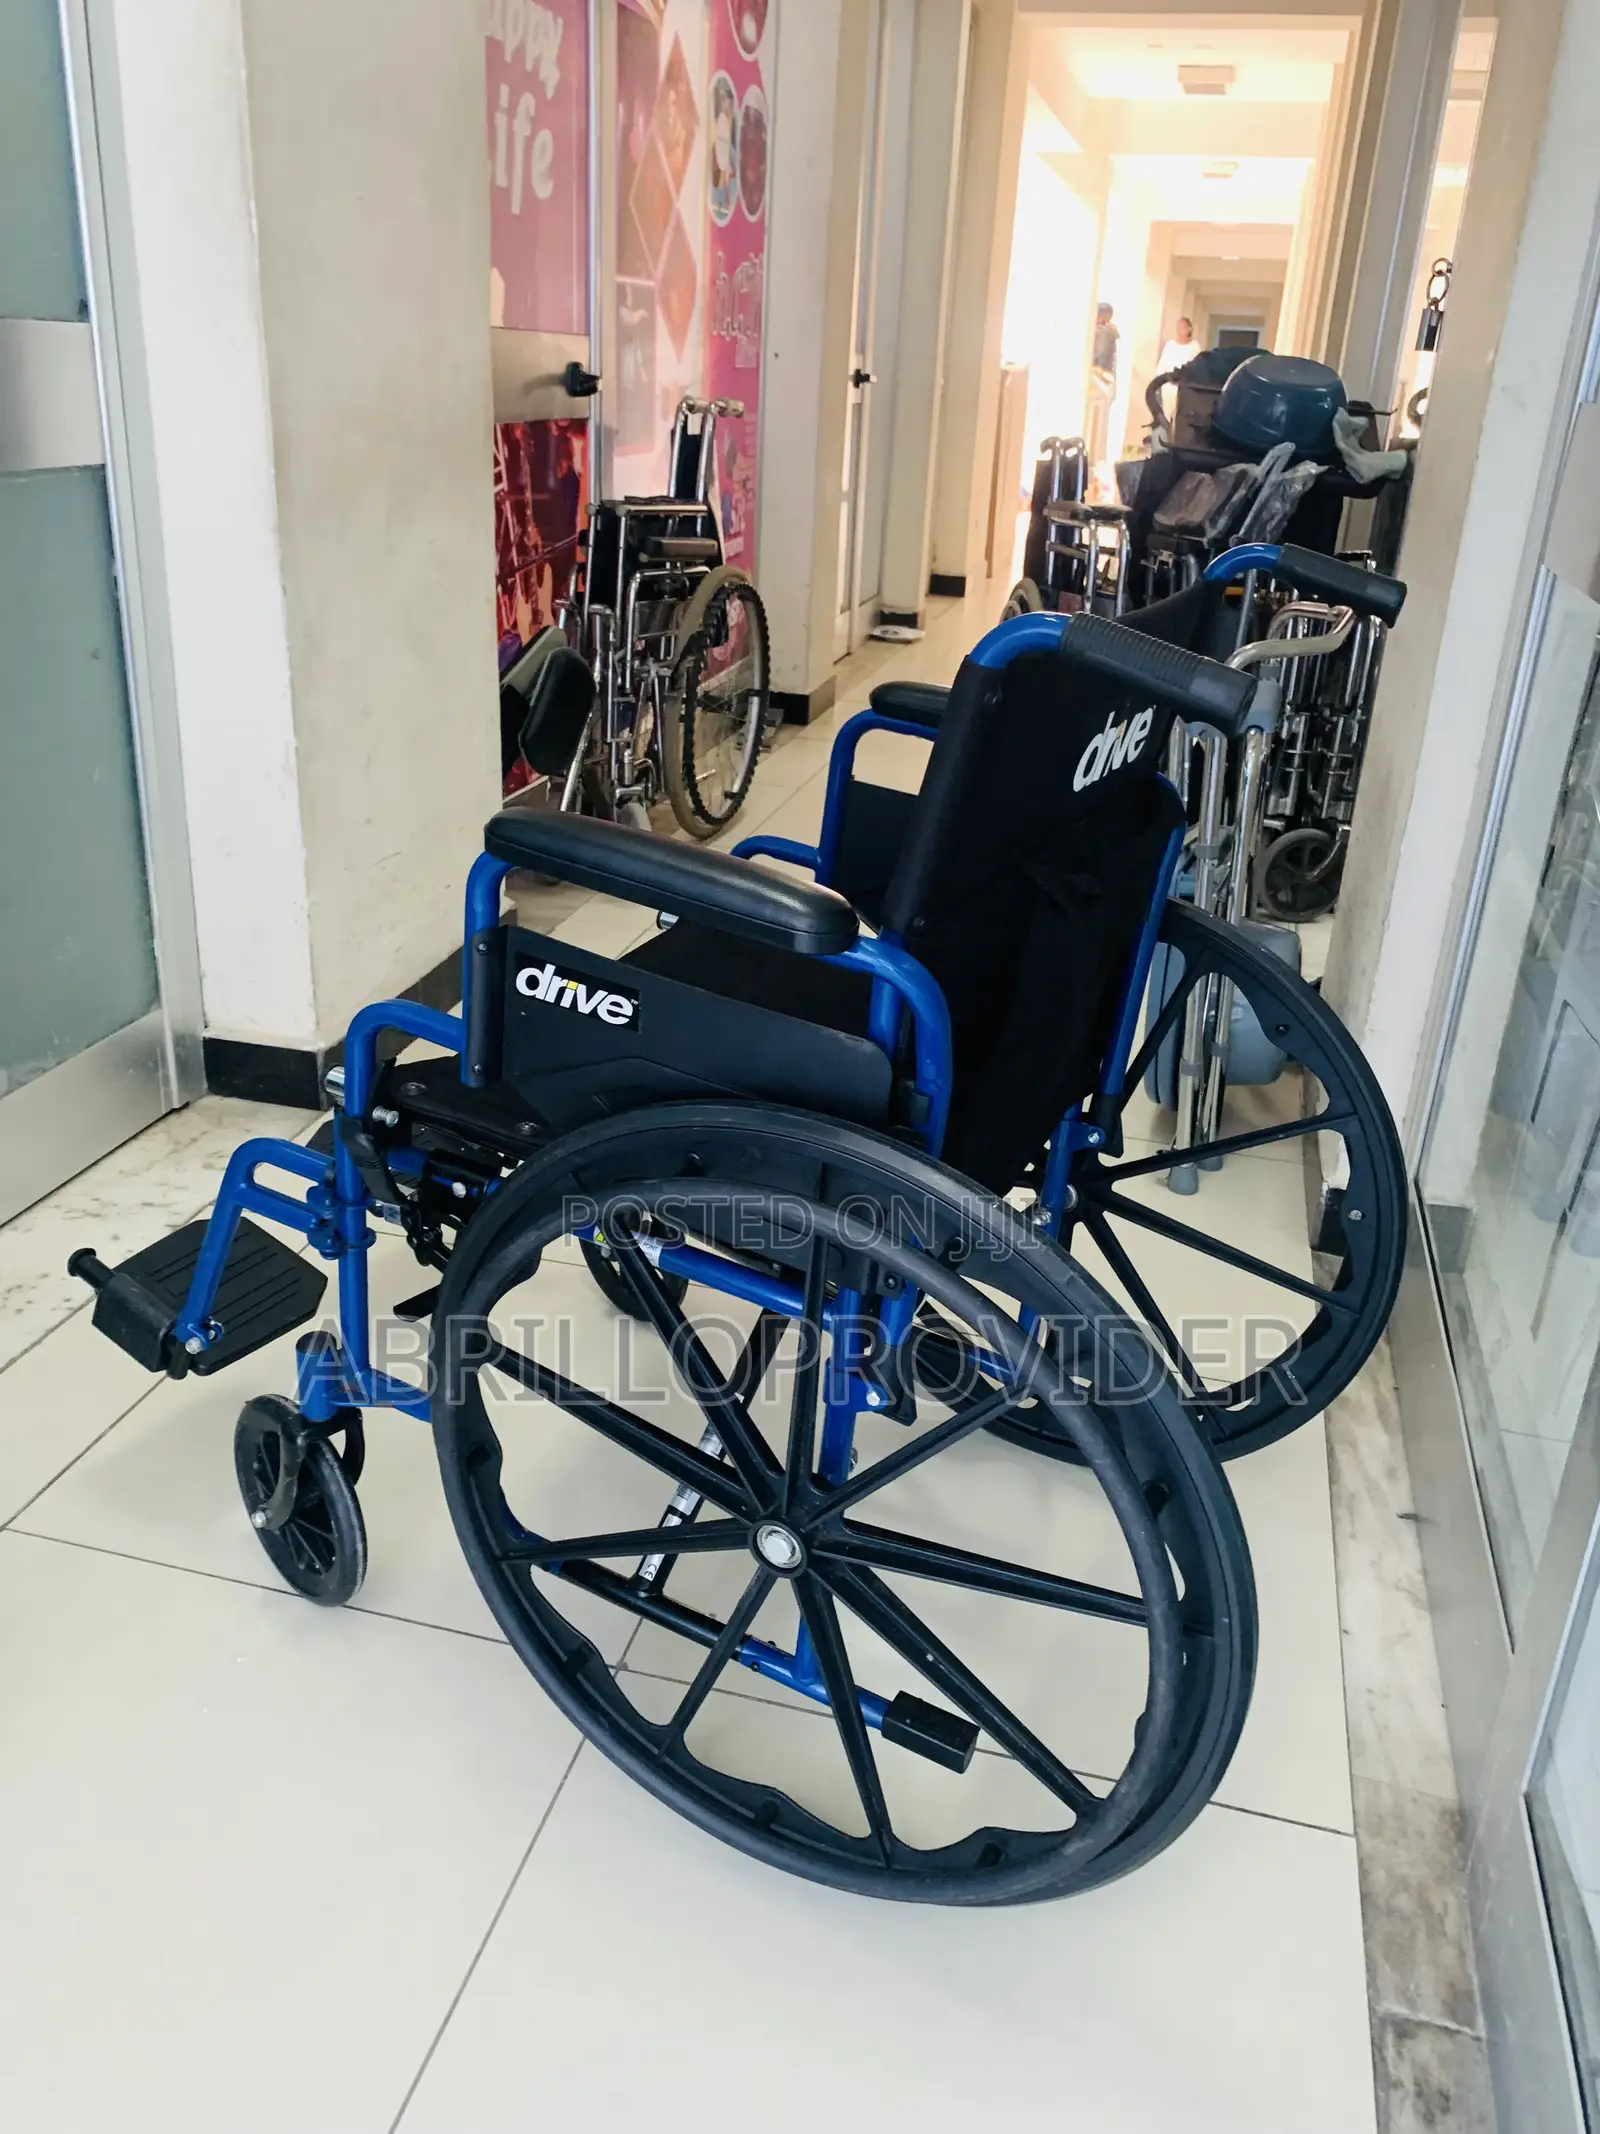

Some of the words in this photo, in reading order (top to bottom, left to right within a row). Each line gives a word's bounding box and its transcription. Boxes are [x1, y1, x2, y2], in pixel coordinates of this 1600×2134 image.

[488, 83, 555, 216] ife
[1073, 707, 1154, 793] drive
[515, 963, 634, 1026] drive
